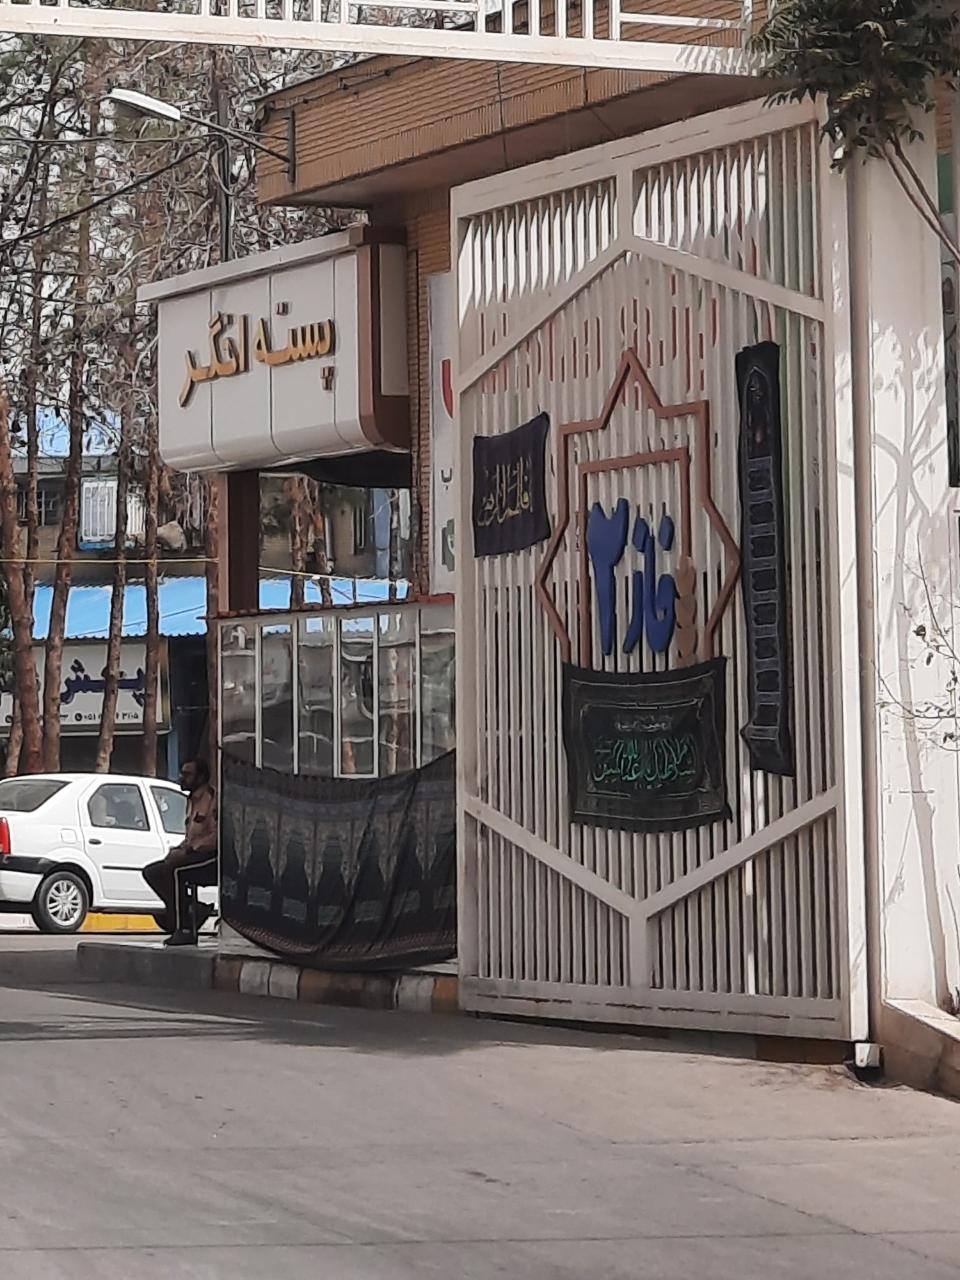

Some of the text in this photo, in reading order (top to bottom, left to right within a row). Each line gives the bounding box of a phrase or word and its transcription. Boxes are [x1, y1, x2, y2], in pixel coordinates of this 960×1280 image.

[254, 301, 337, 392] پسته
[586, 497, 677, 656] فاز ۲
